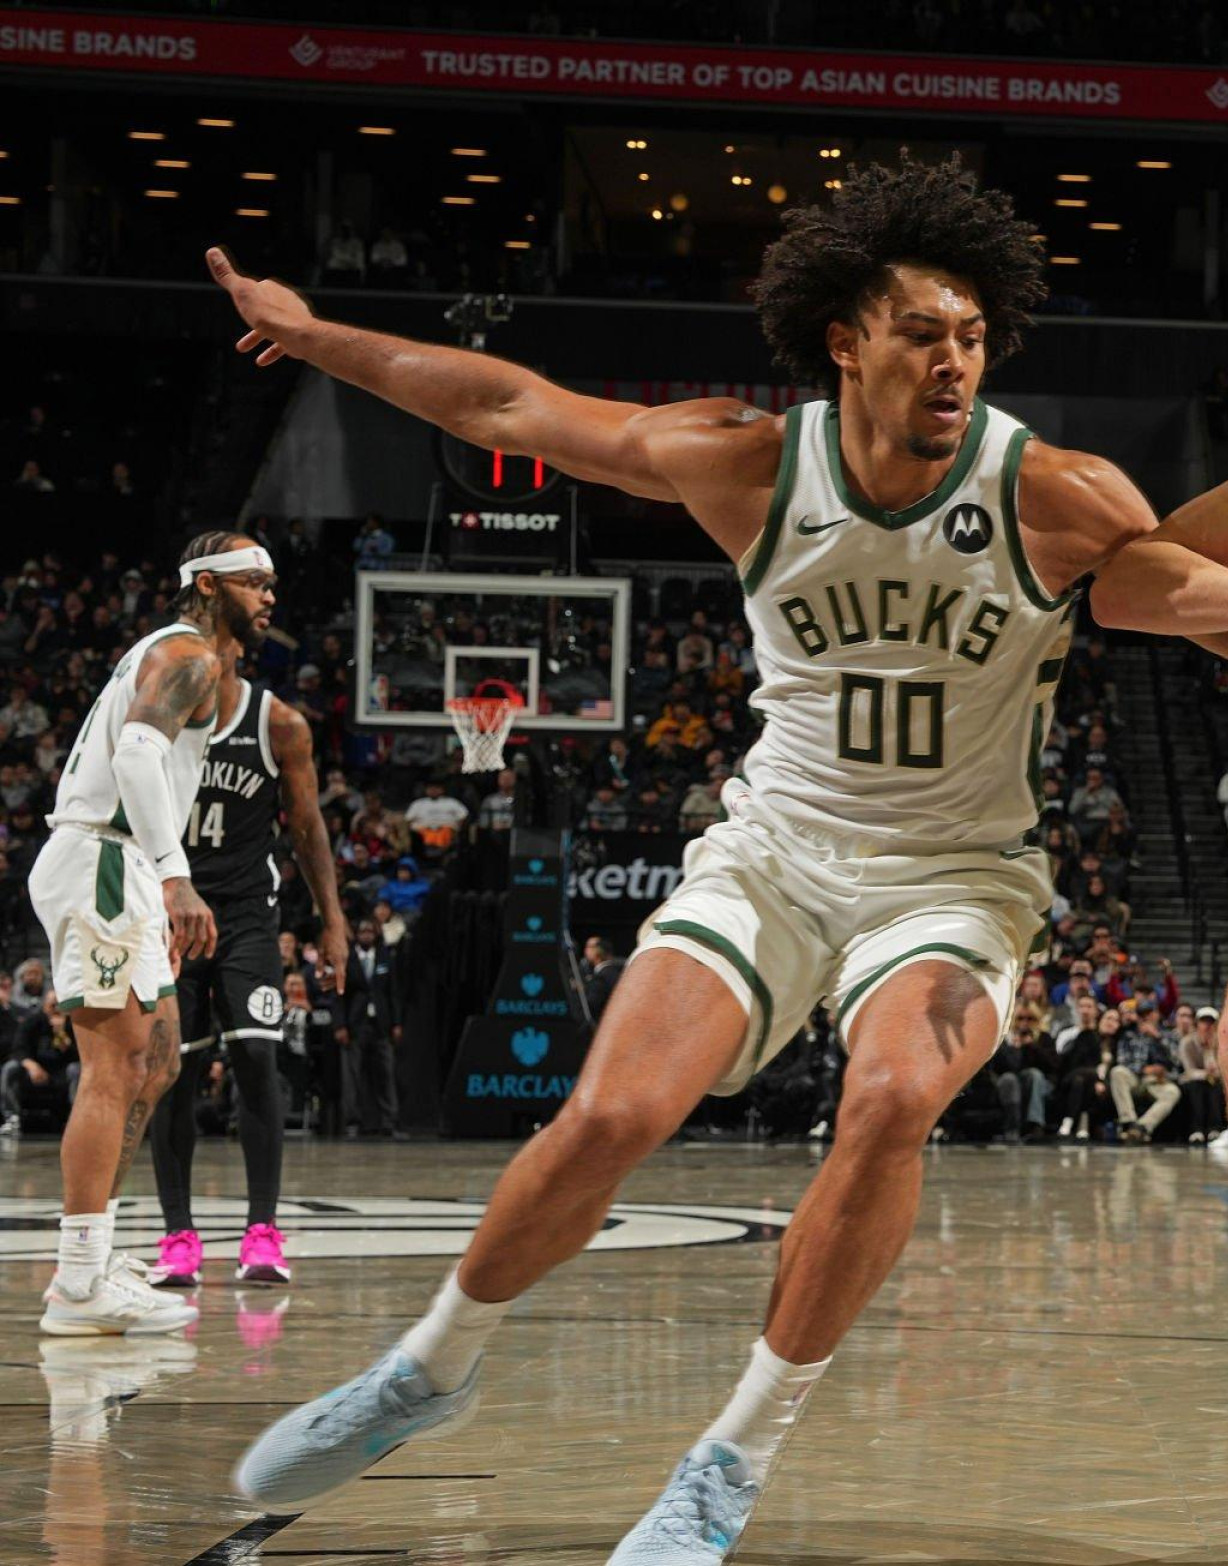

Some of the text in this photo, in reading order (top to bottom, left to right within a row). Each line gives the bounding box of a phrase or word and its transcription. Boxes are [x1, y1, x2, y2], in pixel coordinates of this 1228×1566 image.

[0, 26, 198, 60] SINE BRANDS
[420, 49, 1122, 105] TRUSTED PARTNER OF TOP ASIAN CUISINE BRANDS
[778, 580, 1010, 666] BUCKS
[838, 672, 945, 769] 00
[188, 802, 224, 848] 14
[495, 999, 567, 1016] BARCLAYS
